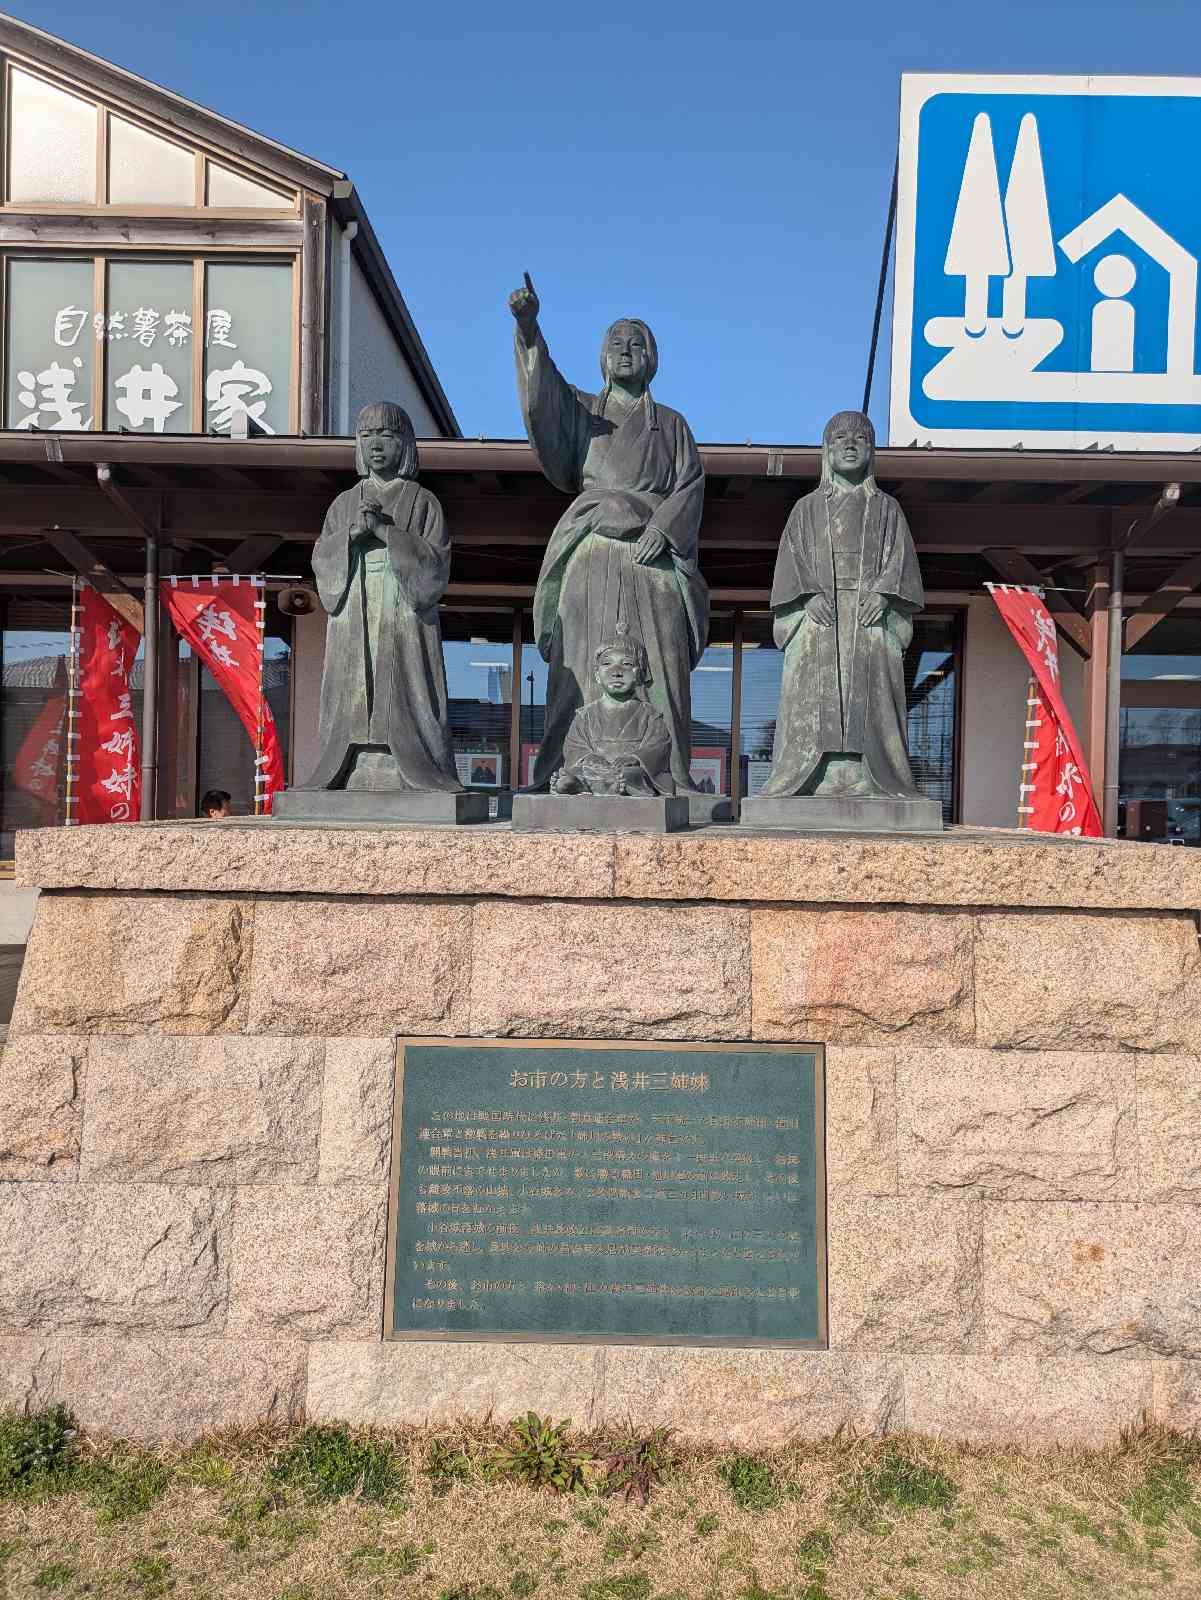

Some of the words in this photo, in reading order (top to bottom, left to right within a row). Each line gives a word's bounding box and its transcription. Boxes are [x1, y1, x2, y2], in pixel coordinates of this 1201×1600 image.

[54, 305, 238, 349] 自然薯茶屋
[14, 357, 275, 435] 浅井家
